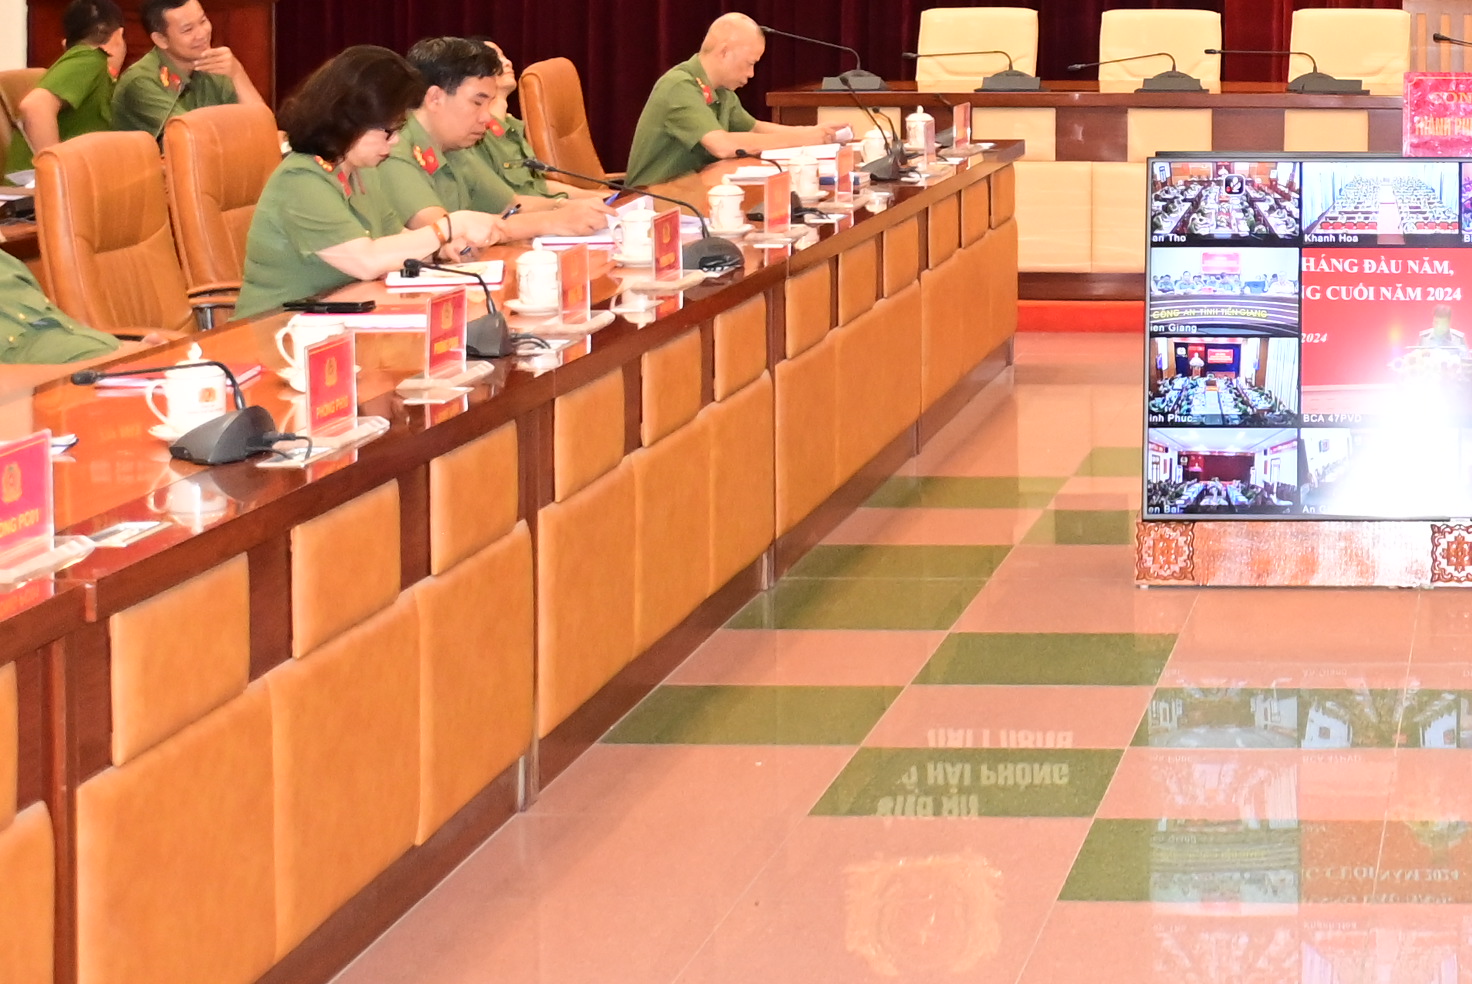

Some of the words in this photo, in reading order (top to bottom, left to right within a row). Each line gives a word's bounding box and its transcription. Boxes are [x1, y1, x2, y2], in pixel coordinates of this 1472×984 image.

[1152, 234, 1165, 243] an
[1168, 233, 1187, 243] Tho
[1304, 233, 1336, 243] Khanh
[1338, 233, 1359, 243] Hoa
[1302, 254, 1358, 274] HÁNG
[1362, 255, 1403, 275] ĐẦU
[1406, 256, 1455, 277] NĂM,
[1325, 282, 1375, 301] CUỐI
[1379, 283, 1422, 301] NĂM
[1426, 287, 1462, 301] 2024
[1150, 323, 1165, 333] ien
[1168, 323, 1197, 335] Giang
[1149, 413, 1164, 423] inh
[1167, 413, 1193, 423] Phuc
[1302, 413, 1325, 423] BCA
